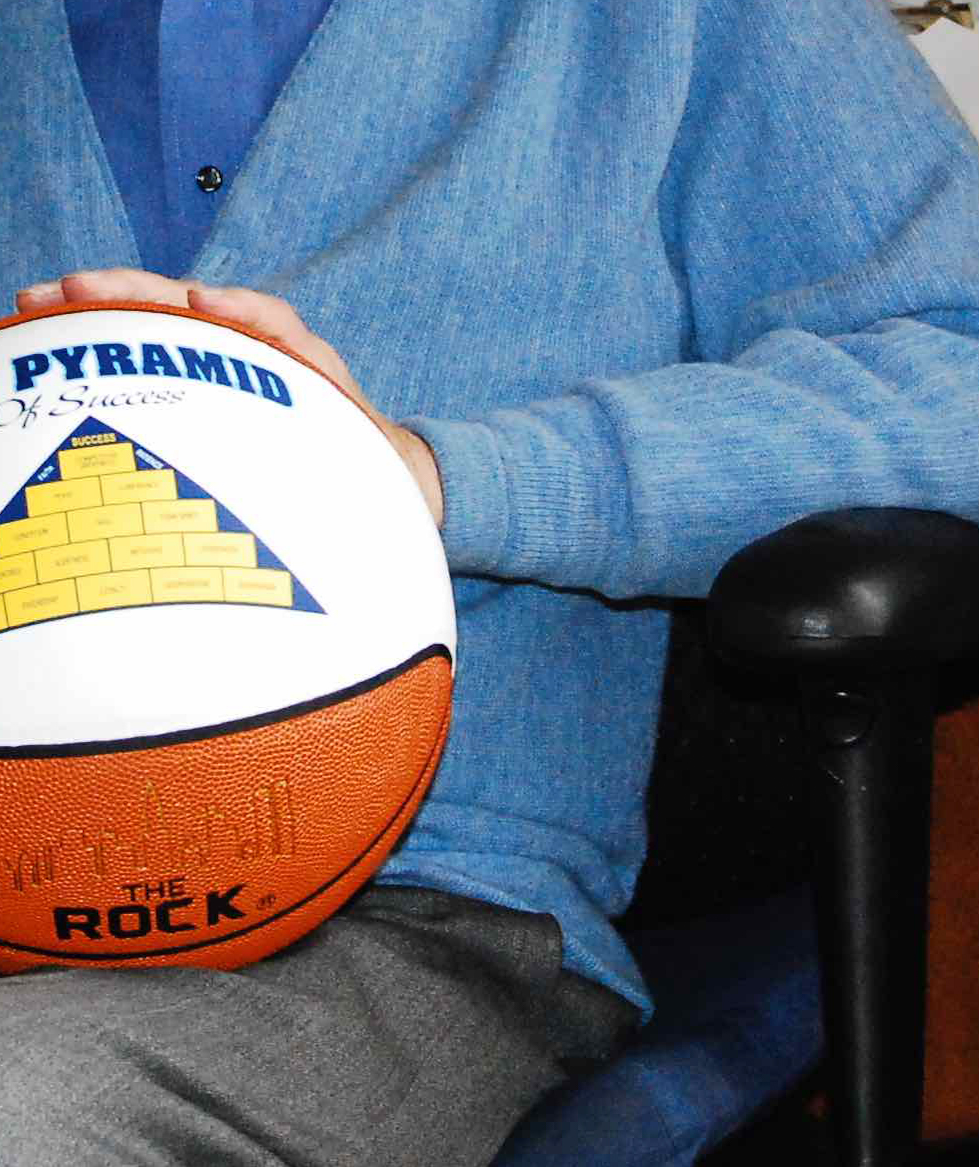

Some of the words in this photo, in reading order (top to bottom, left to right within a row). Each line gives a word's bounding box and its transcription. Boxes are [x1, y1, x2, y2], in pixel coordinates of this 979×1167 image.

[11, 341, 295, 409] PYRAMID
[48, 384, 187, 418] Success
[71, 433, 117, 448] SUCCESS
[122, 877, 189, 903] THE
[53, 883, 249, 940] ROCK
